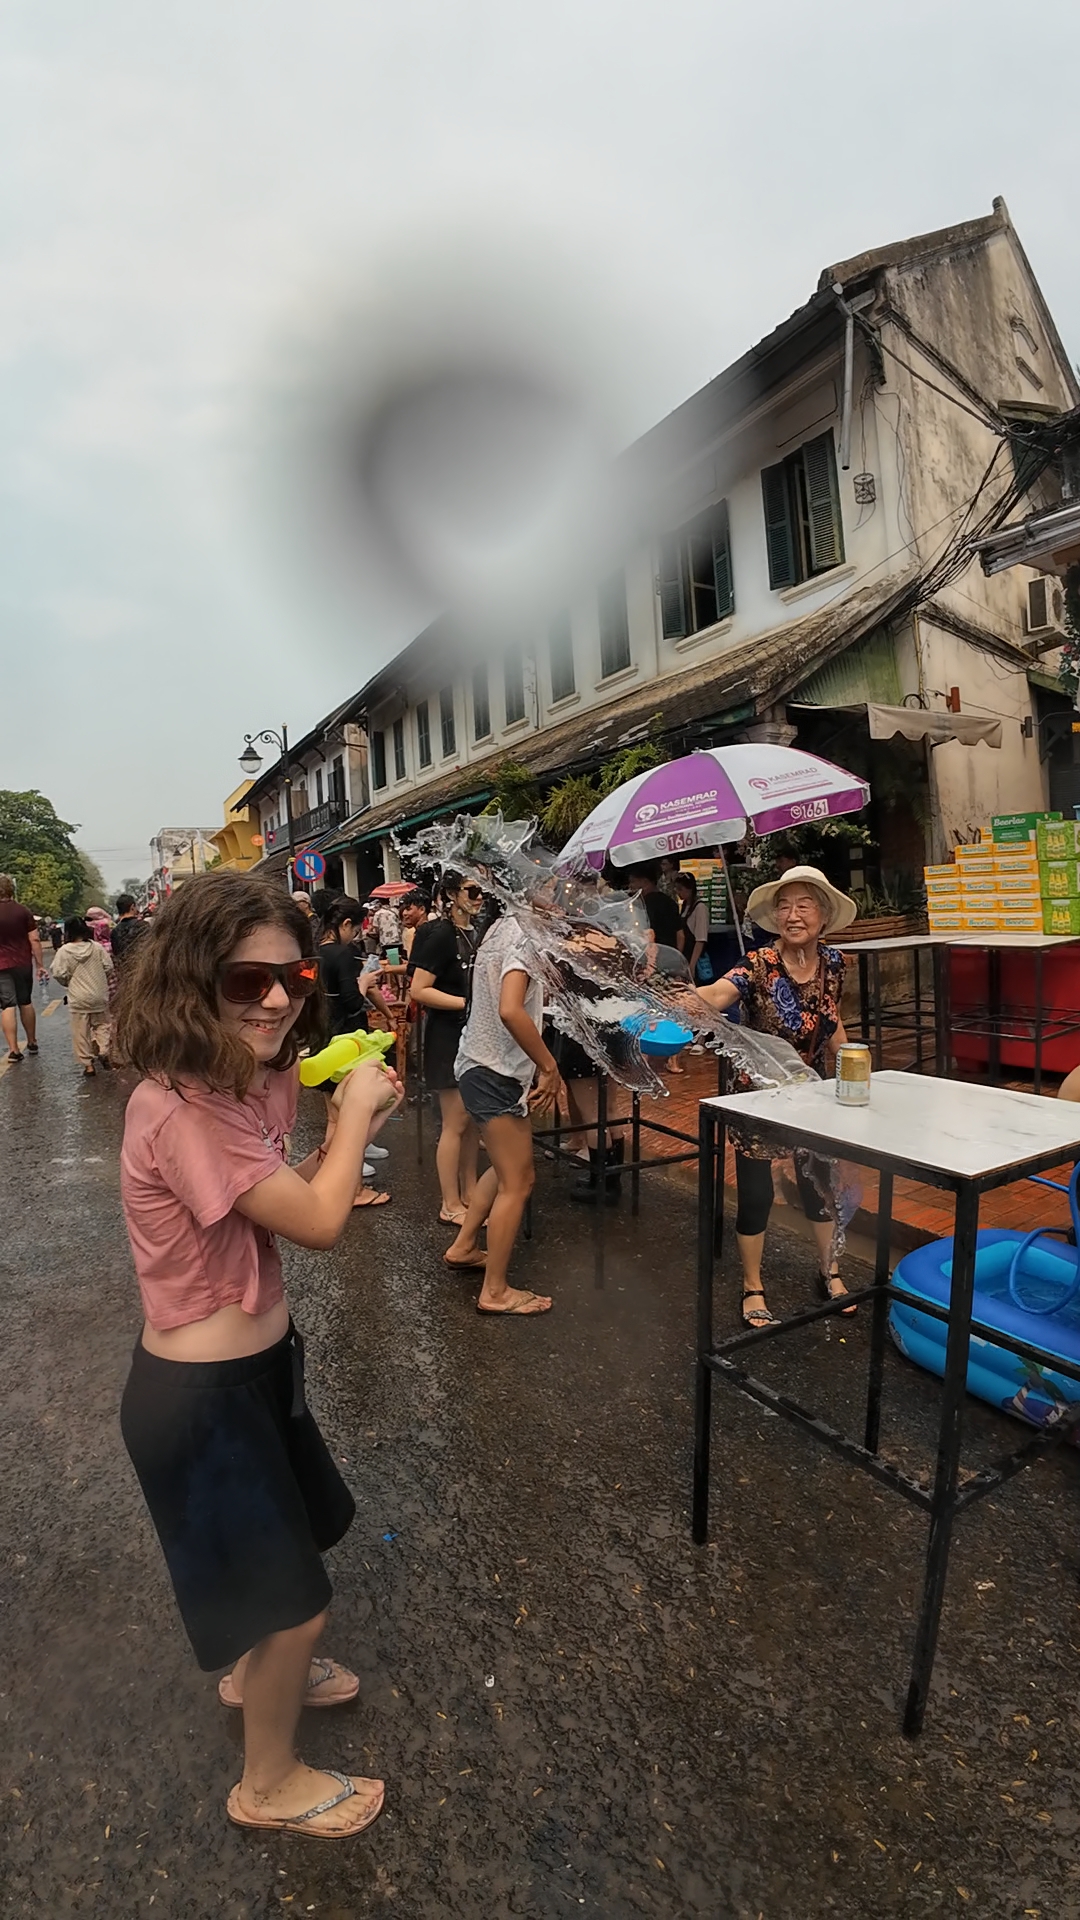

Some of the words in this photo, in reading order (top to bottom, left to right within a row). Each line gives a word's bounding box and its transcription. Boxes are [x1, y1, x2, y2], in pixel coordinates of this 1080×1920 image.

[768, 766, 818, 782] KASEMRAD
[660, 790, 717, 810] KASEMRAD
[801, 801, 828, 819] 1661
[994, 817, 1026, 827] Beerlao
[669, 831, 699, 850] 1661
